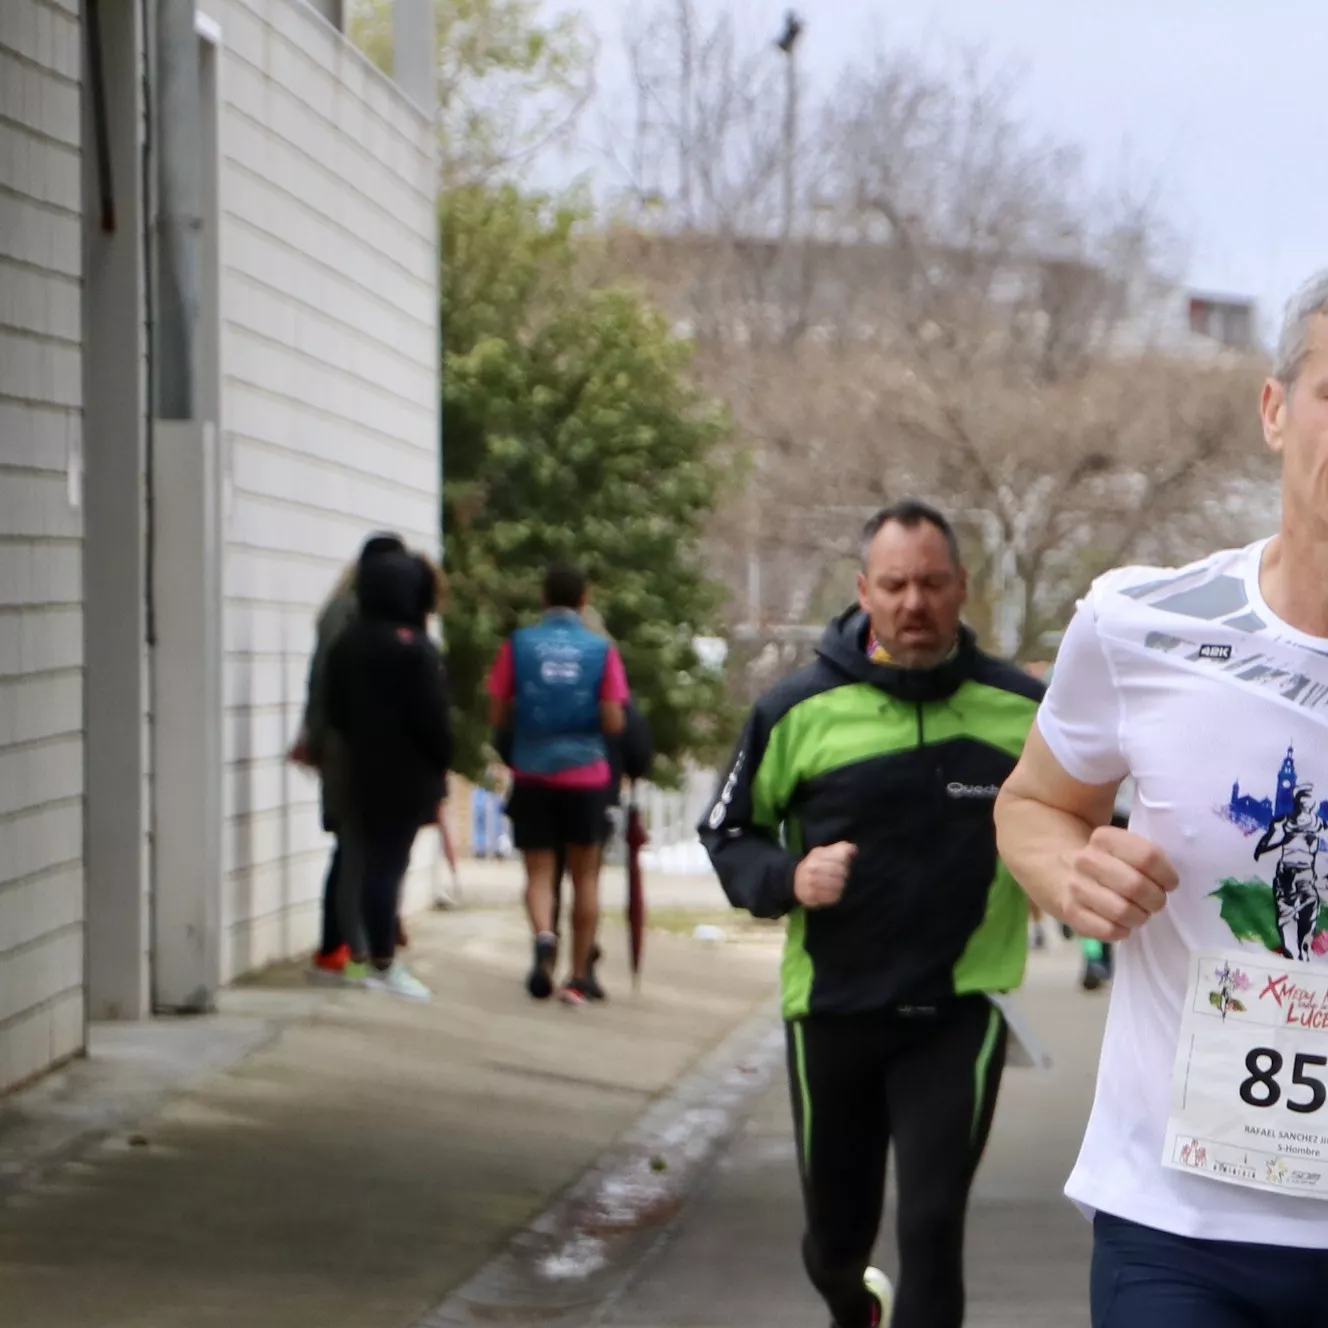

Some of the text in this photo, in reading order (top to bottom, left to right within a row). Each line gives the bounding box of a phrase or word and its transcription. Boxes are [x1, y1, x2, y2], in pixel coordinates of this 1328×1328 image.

[1244, 1125, 1276, 1138] RAFAEL
[1279, 1131, 1318, 1144] SANCHEZ
[1277, 1144, 1320, 1156] S-Hombre
